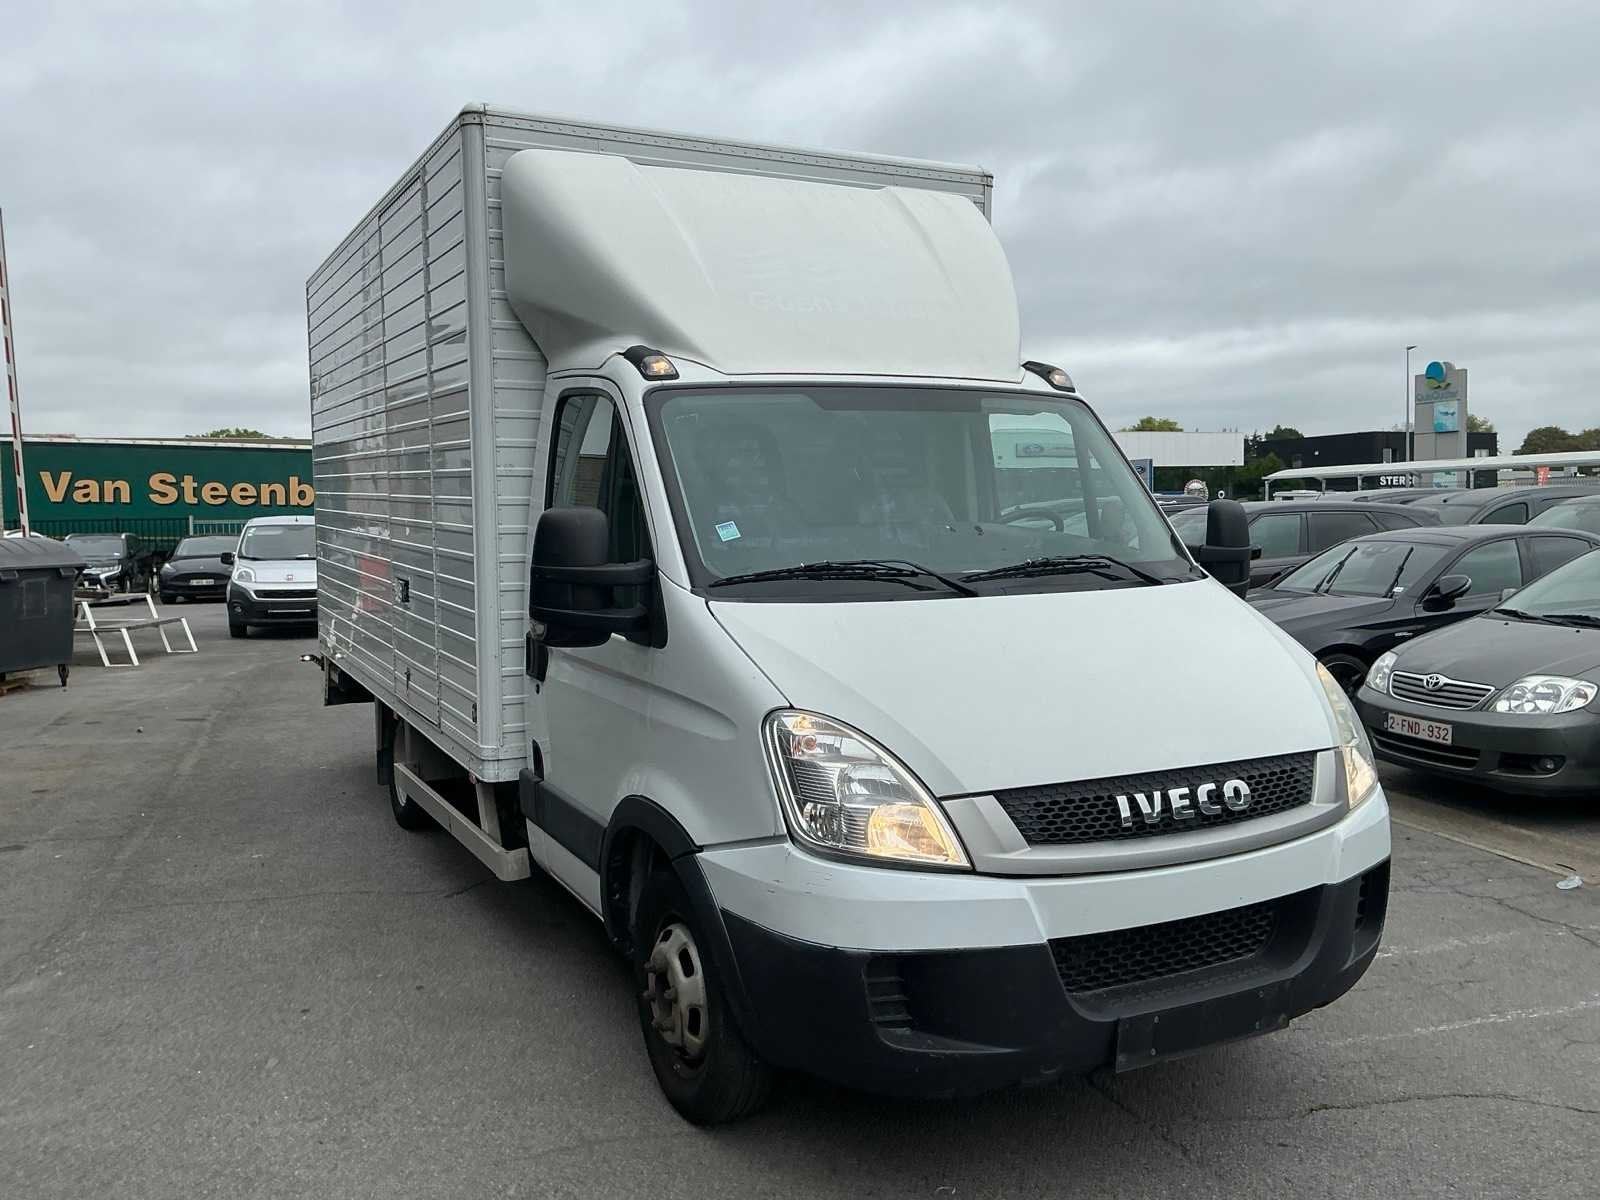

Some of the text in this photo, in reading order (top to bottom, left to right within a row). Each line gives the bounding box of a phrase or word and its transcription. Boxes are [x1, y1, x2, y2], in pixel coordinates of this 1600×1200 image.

[39, 471, 314, 506] Van Steenb
[1389, 716, 1449, 741] 2-FND-932
[1116, 779, 1251, 827] IVECO
